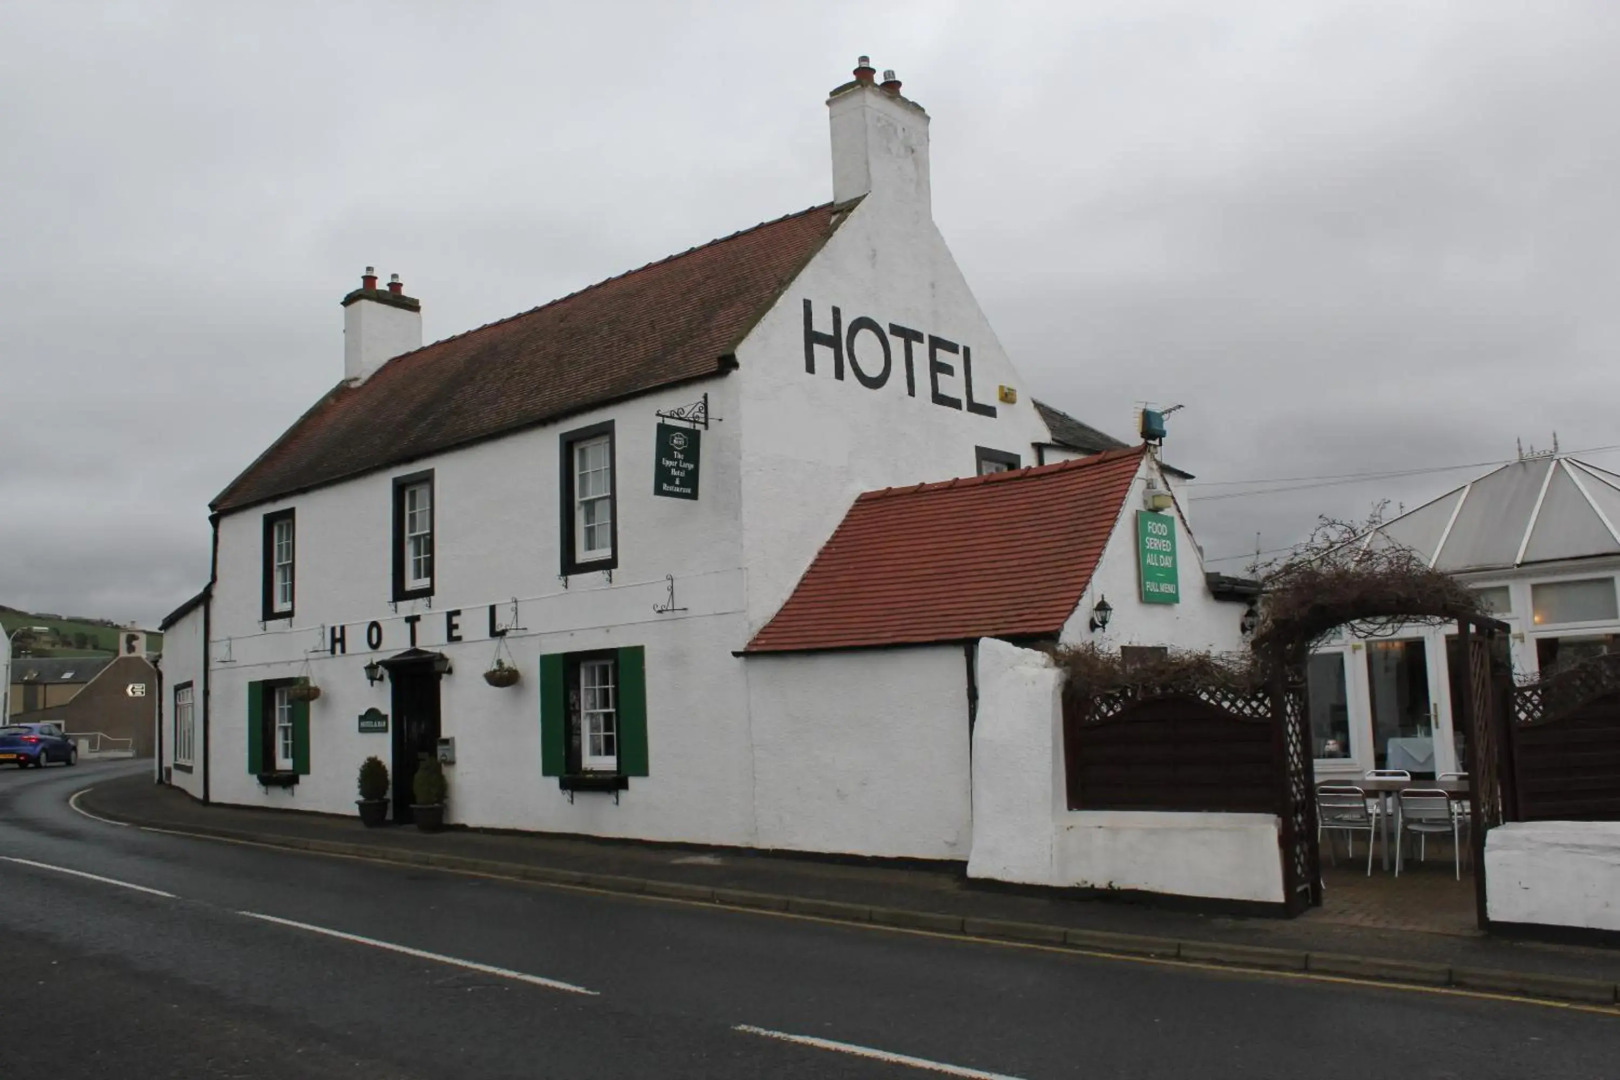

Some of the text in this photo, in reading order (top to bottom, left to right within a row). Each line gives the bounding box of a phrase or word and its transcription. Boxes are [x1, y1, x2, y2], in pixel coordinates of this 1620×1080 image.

[803, 298, 997, 418] HOTEL
[662, 458, 678, 467] Upper
[674, 451, 685, 459] The
[1147, 521, 1168, 536] FOOD
[1145, 537, 1172, 552] SERVED
[1146, 553, 1173, 568] ALL DAY
[1146, 581, 1176, 594] FULL MENU
[330, 604, 507, 655] HOTEL
